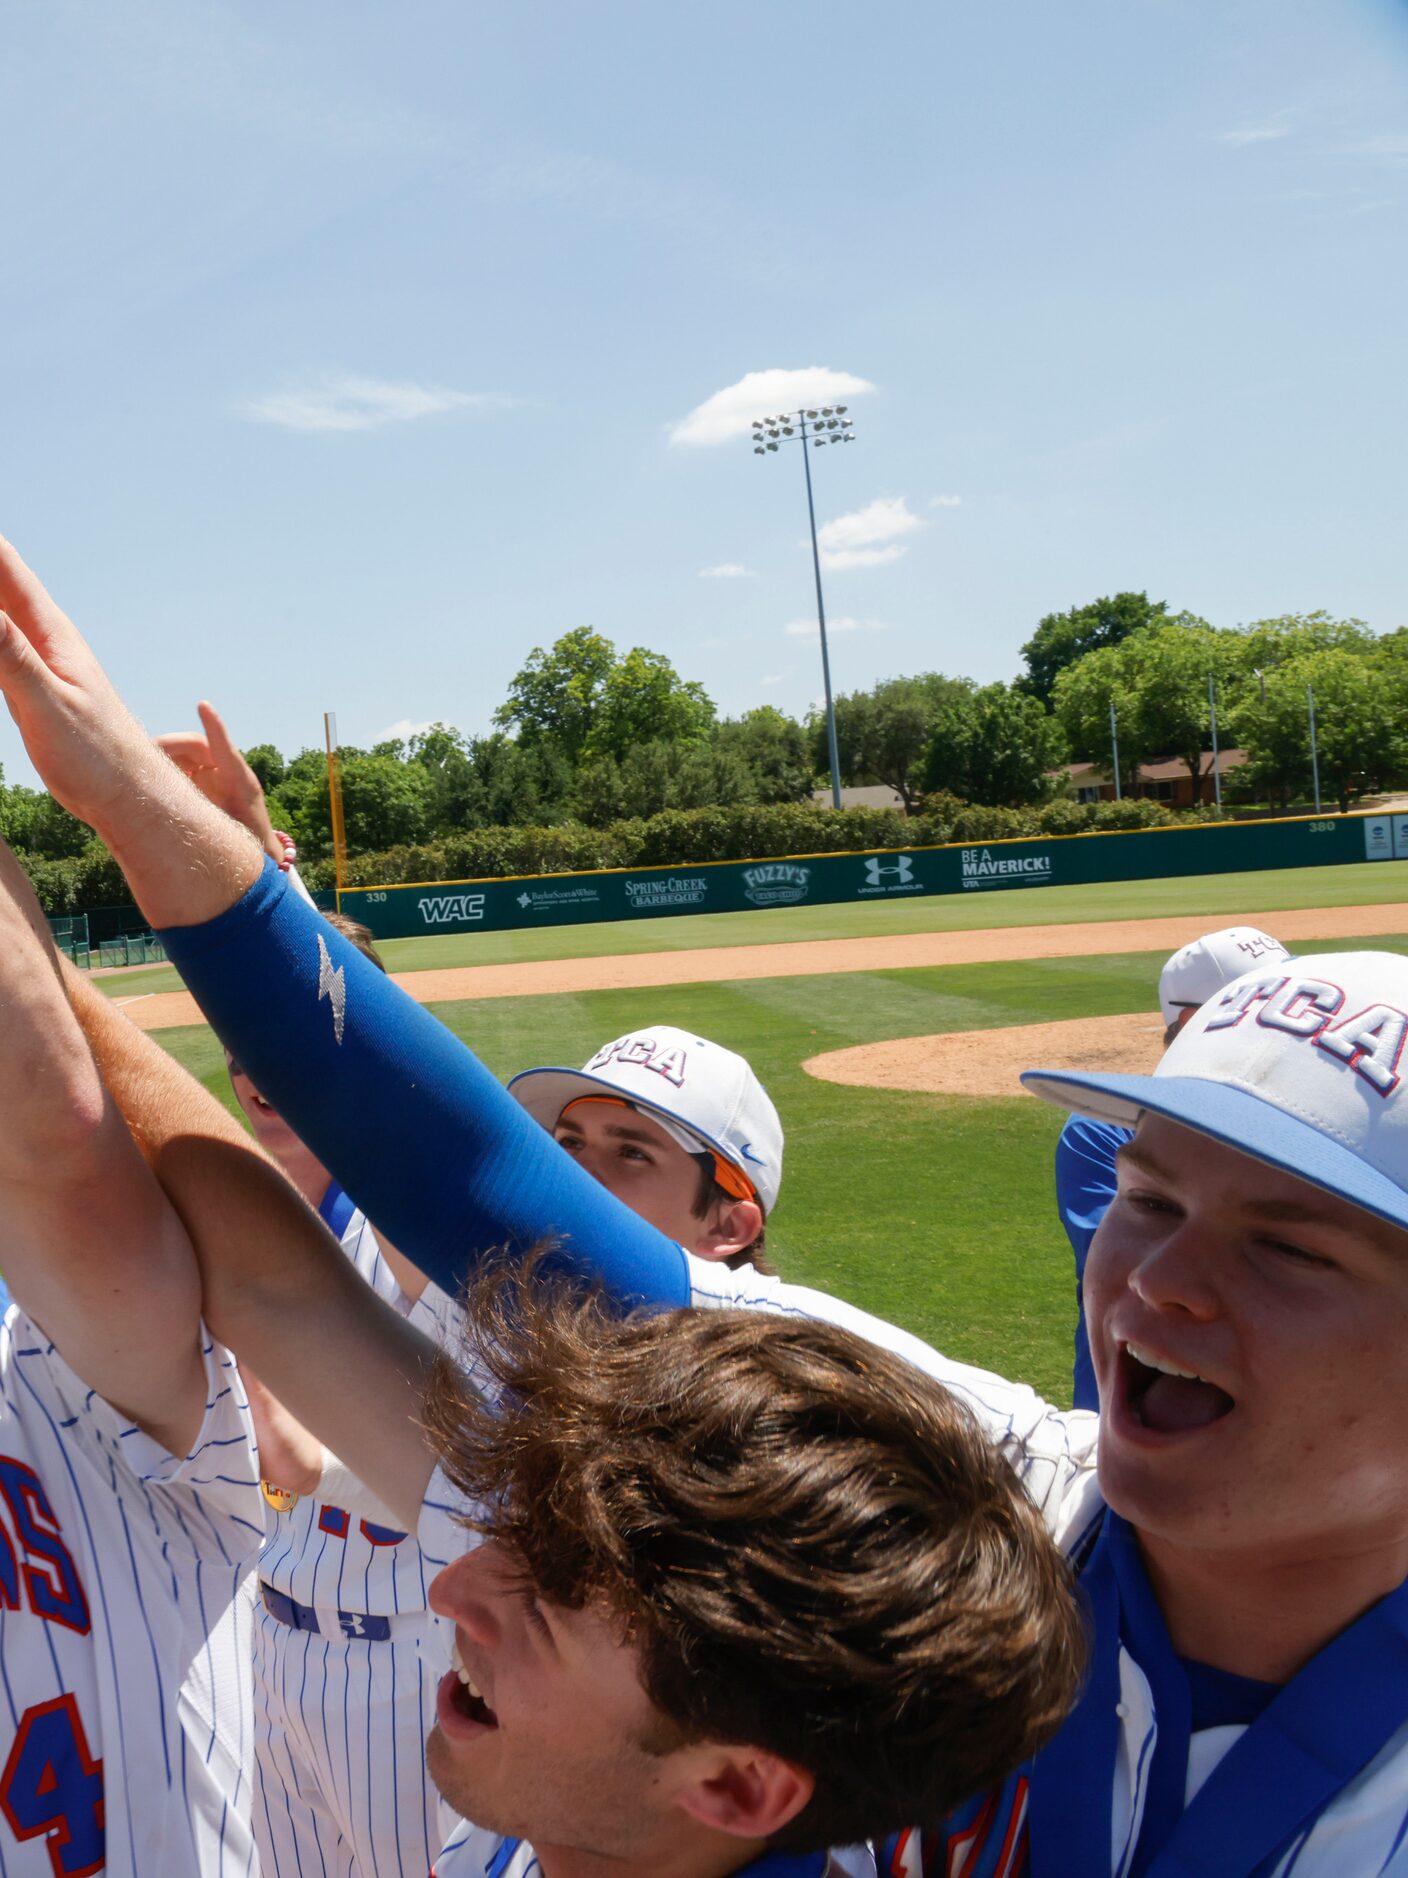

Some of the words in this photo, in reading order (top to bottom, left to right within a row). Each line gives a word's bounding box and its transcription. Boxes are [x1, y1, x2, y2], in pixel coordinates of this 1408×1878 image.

[1308, 820, 1336, 833] 380
[961, 849, 978, 863] BE
[980, 848, 992, 862] A
[962, 856, 1051, 876] MAVERICK!
[744, 864, 809, 888] FUZZY'S
[365, 892, 387, 903] 330
[417, 894, 485, 923] WAC
[1203, 976, 1408, 1099] TCA
[591, 1038, 687, 1088] TCA
